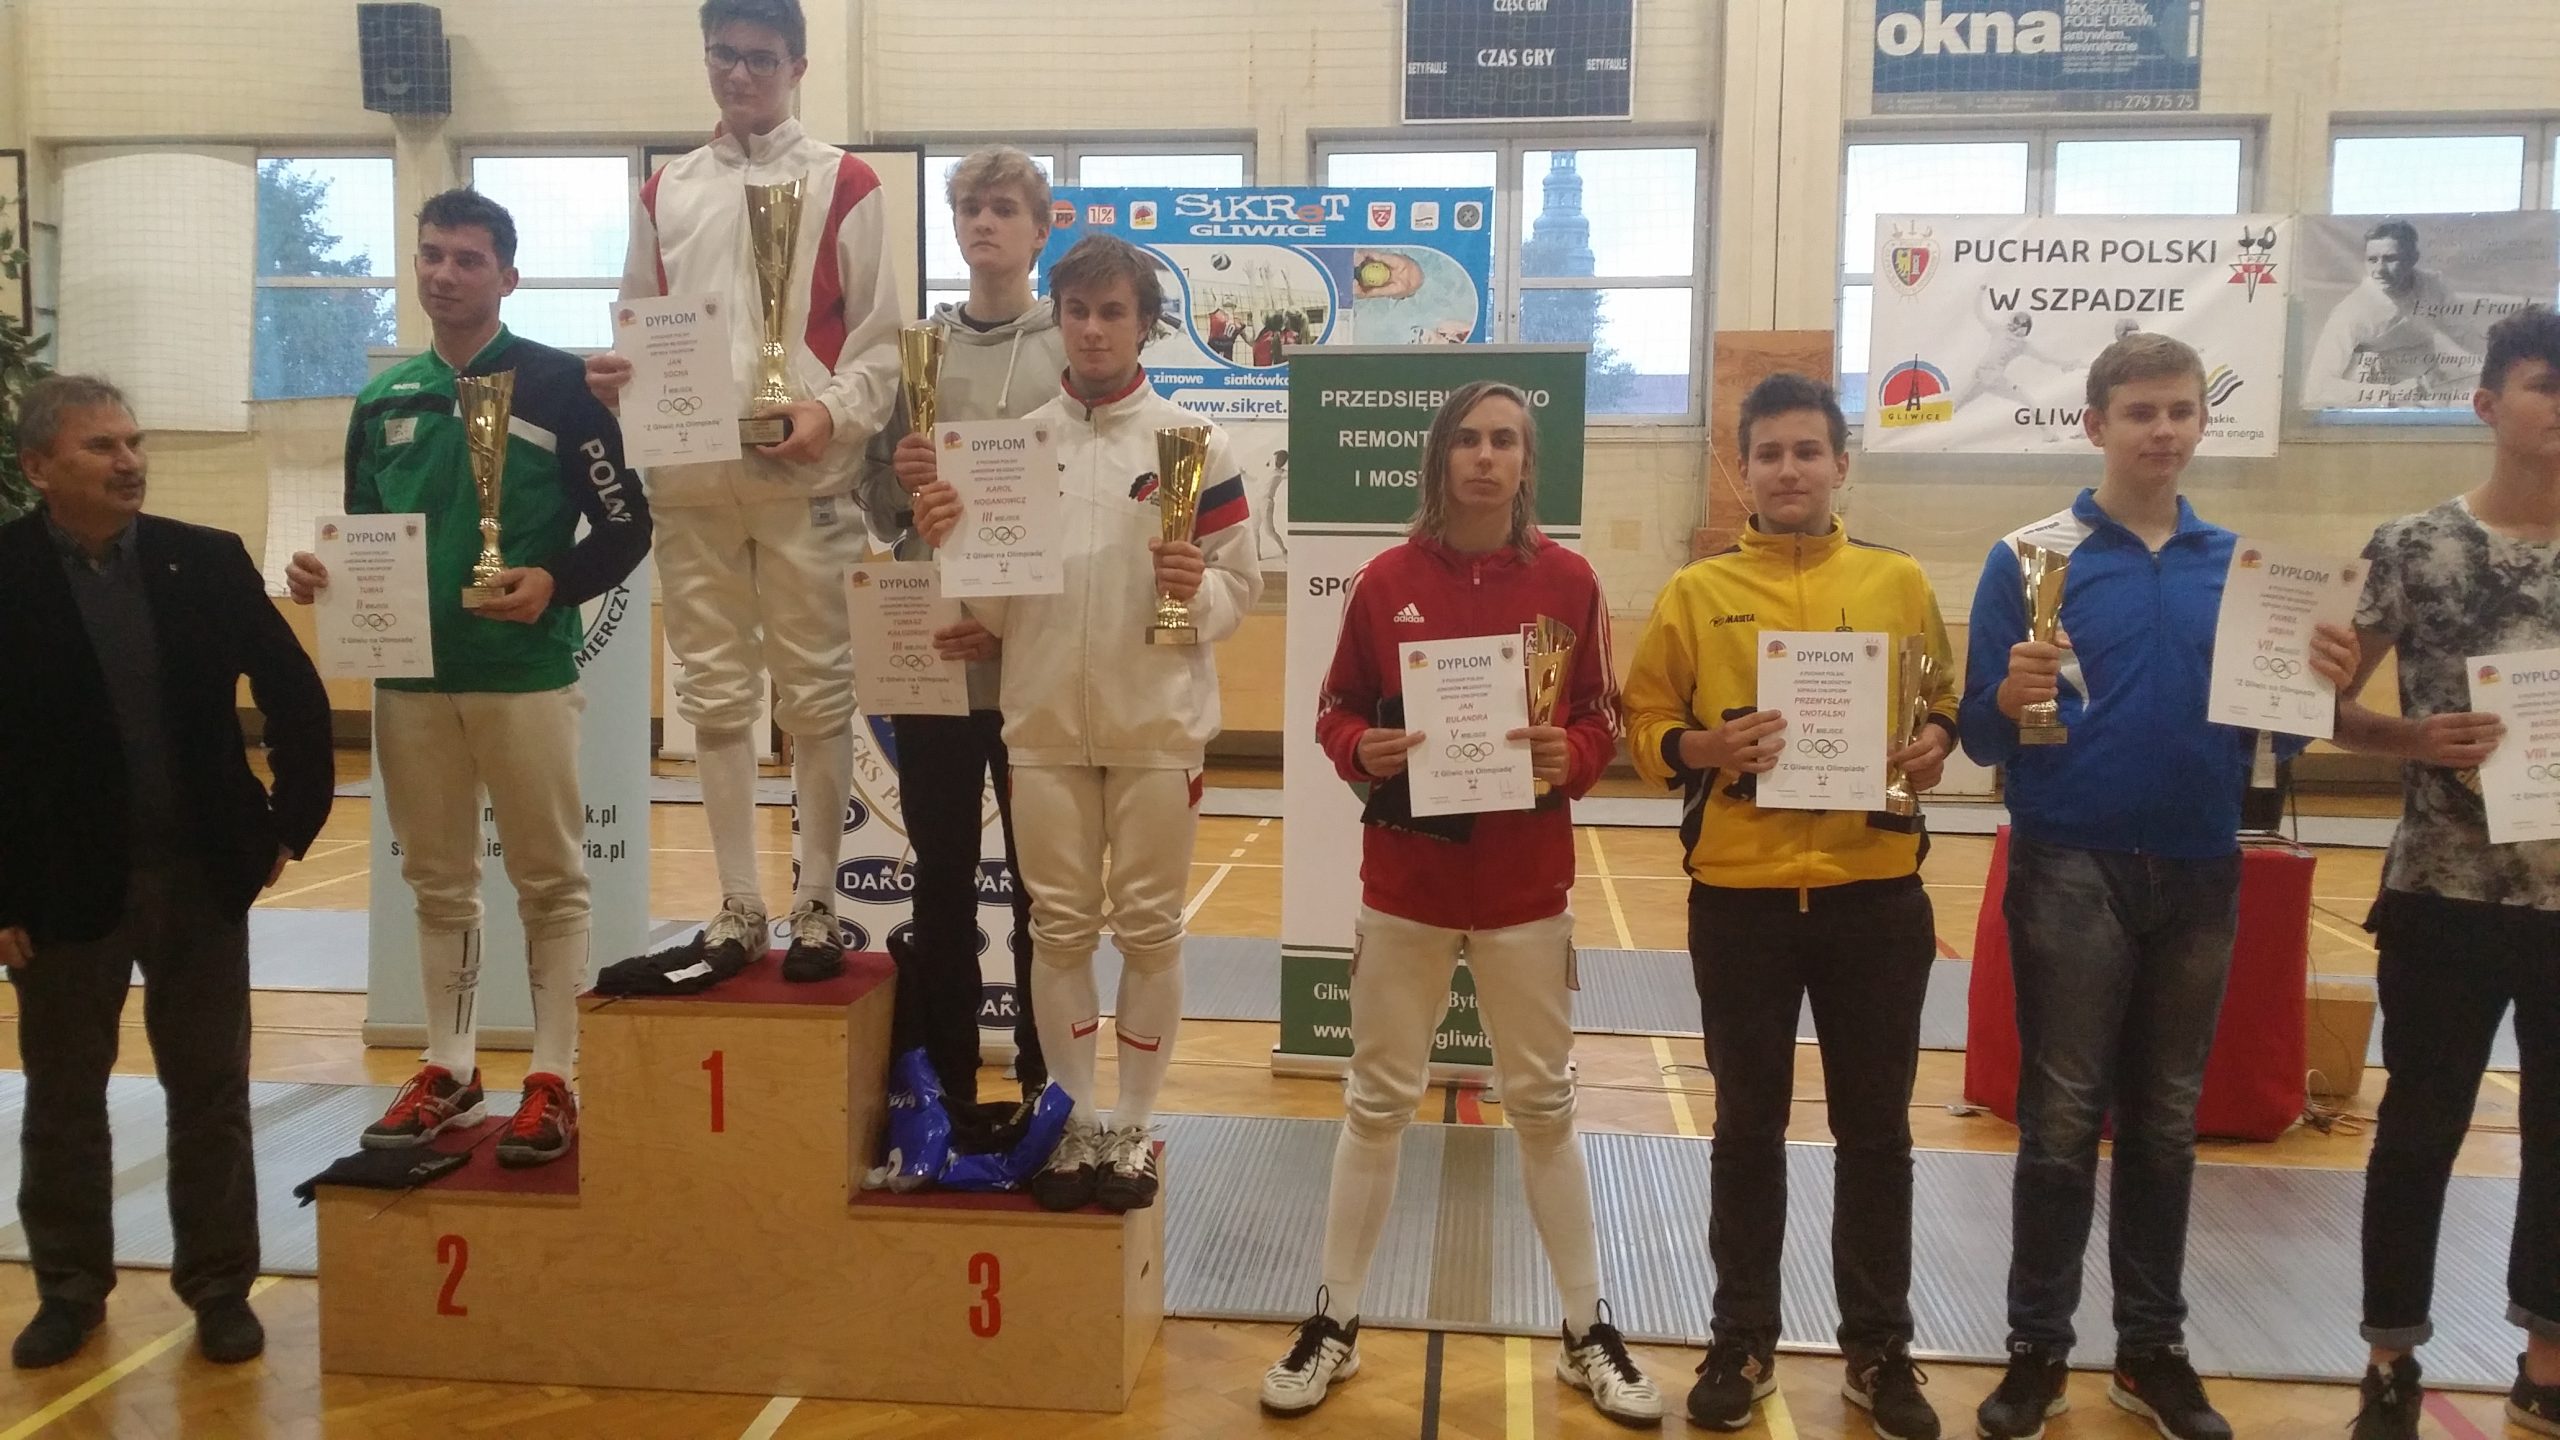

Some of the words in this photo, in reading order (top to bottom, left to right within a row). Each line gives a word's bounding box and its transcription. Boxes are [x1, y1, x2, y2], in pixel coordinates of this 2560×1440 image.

[1877, 0, 2061, 56] okna
[1477, 48, 1518, 67] CZAS
[1522, 48, 1556, 66] GRY
[2125, 95, 2150, 109] 279
[2155, 94, 2172, 109] 75
[2176, 94, 2194, 109] 75
[1190, 225, 1327, 237] GLIWICE
[1954, 239, 2090, 264] PUCHAR
[2101, 239, 2218, 264] POLSKI
[1990, 288, 2020, 311] W
[2030, 288, 2185, 312] SZPADZIE
[645, 312, 697, 328] DYPLOM
[1153, 372, 1204, 384] zimowe
[1888, 413, 1940, 421] GLIWICE
[2227, 430, 2265, 440] energia
[971, 438, 1025, 452] DYPLOM
[347, 532, 396, 543] DYPLOM
[2269, 563, 2330, 583] DYPLOM
[880, 578, 930, 590] DYPLOM
[1393, 615, 1425, 624] adidas
[1437, 656, 1492, 671] DYPLOM
[1796, 650, 1854, 663] DYPLOM
[1458, 702, 1474, 710] JAN
[1450, 729, 1459, 740] V
[1801, 722, 1815, 733] VI
[702, 1049, 724, 1133] 1
[436, 1234, 469, 1317] 2
[968, 1252, 1001, 1338] 3
